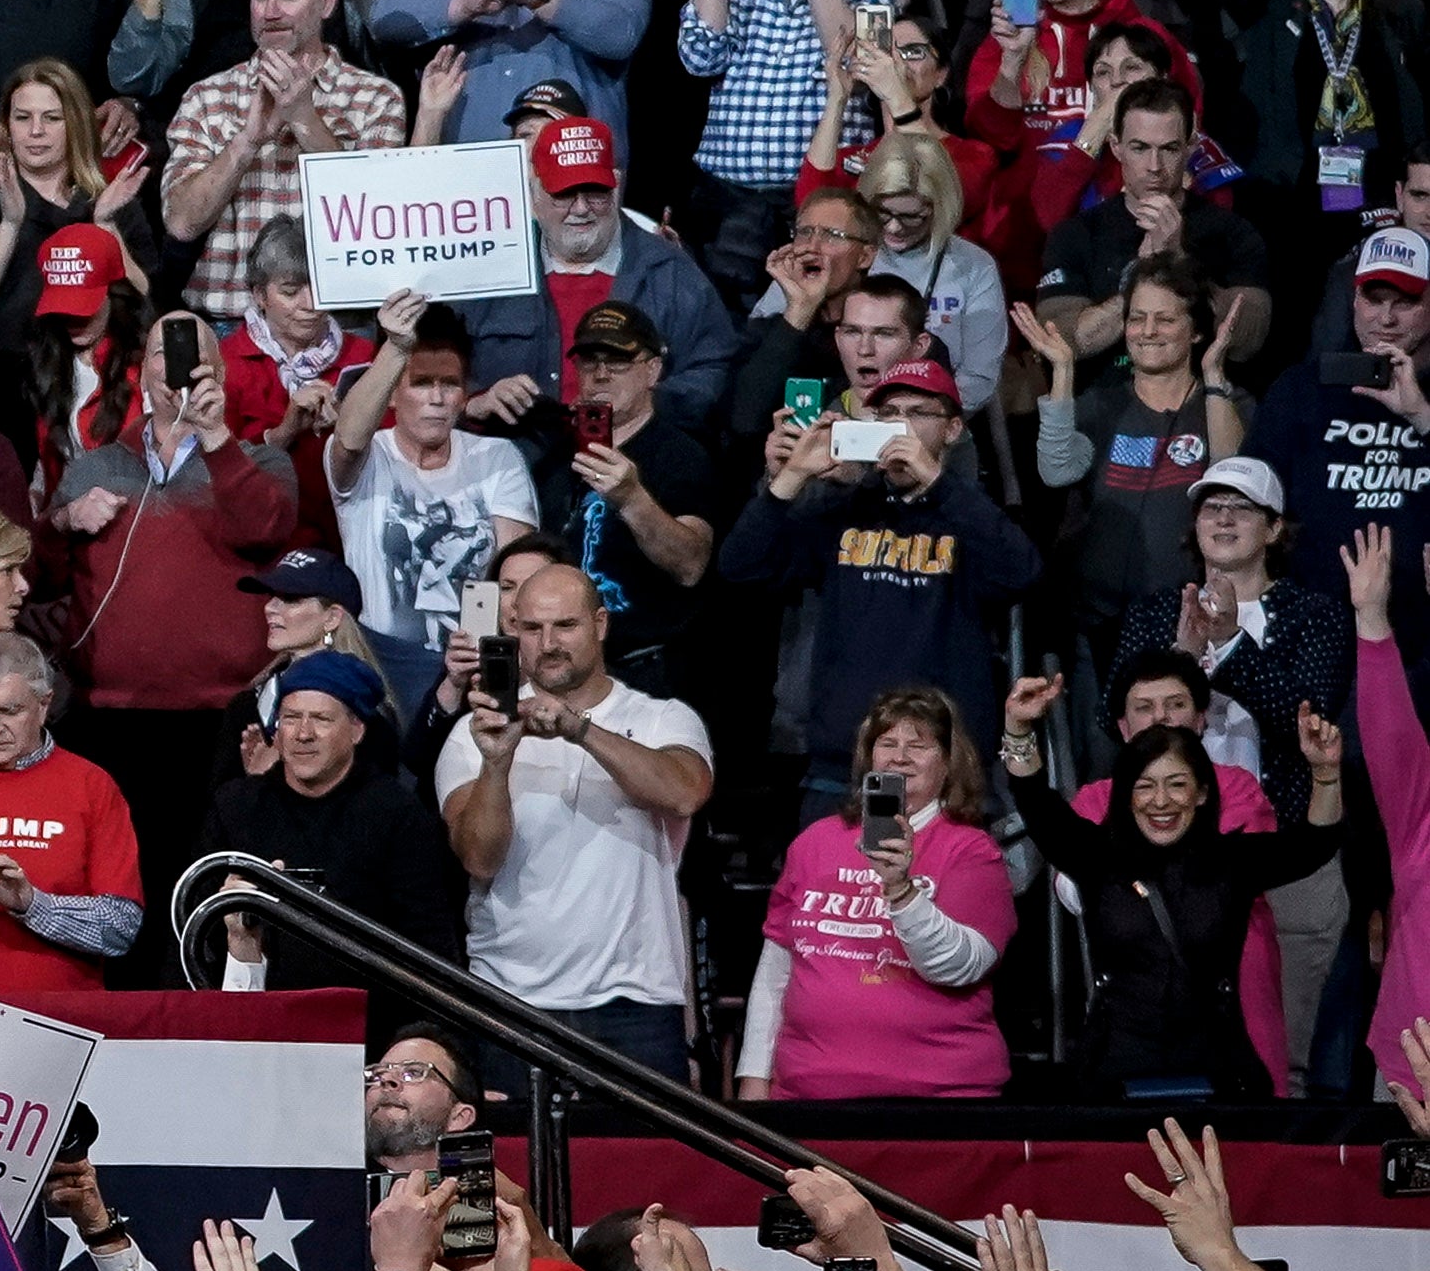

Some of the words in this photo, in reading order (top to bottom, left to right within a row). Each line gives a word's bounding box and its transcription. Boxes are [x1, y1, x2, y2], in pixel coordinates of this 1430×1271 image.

[561, 126, 593, 140] KEEP
[549, 138, 605, 155] AMERICA
[318, 192, 514, 244] Women
[344, 246, 396, 268] FOR
[403, 239, 497, 264] TRUMP
[1370, 242, 1416, 261] TRUMP
[1325, 419, 1420, 451] POLIC
[1362, 449, 1400, 467] FOR
[1325, 463, 1430, 493] TRUMP
[1353, 490, 1406, 510] 2020
